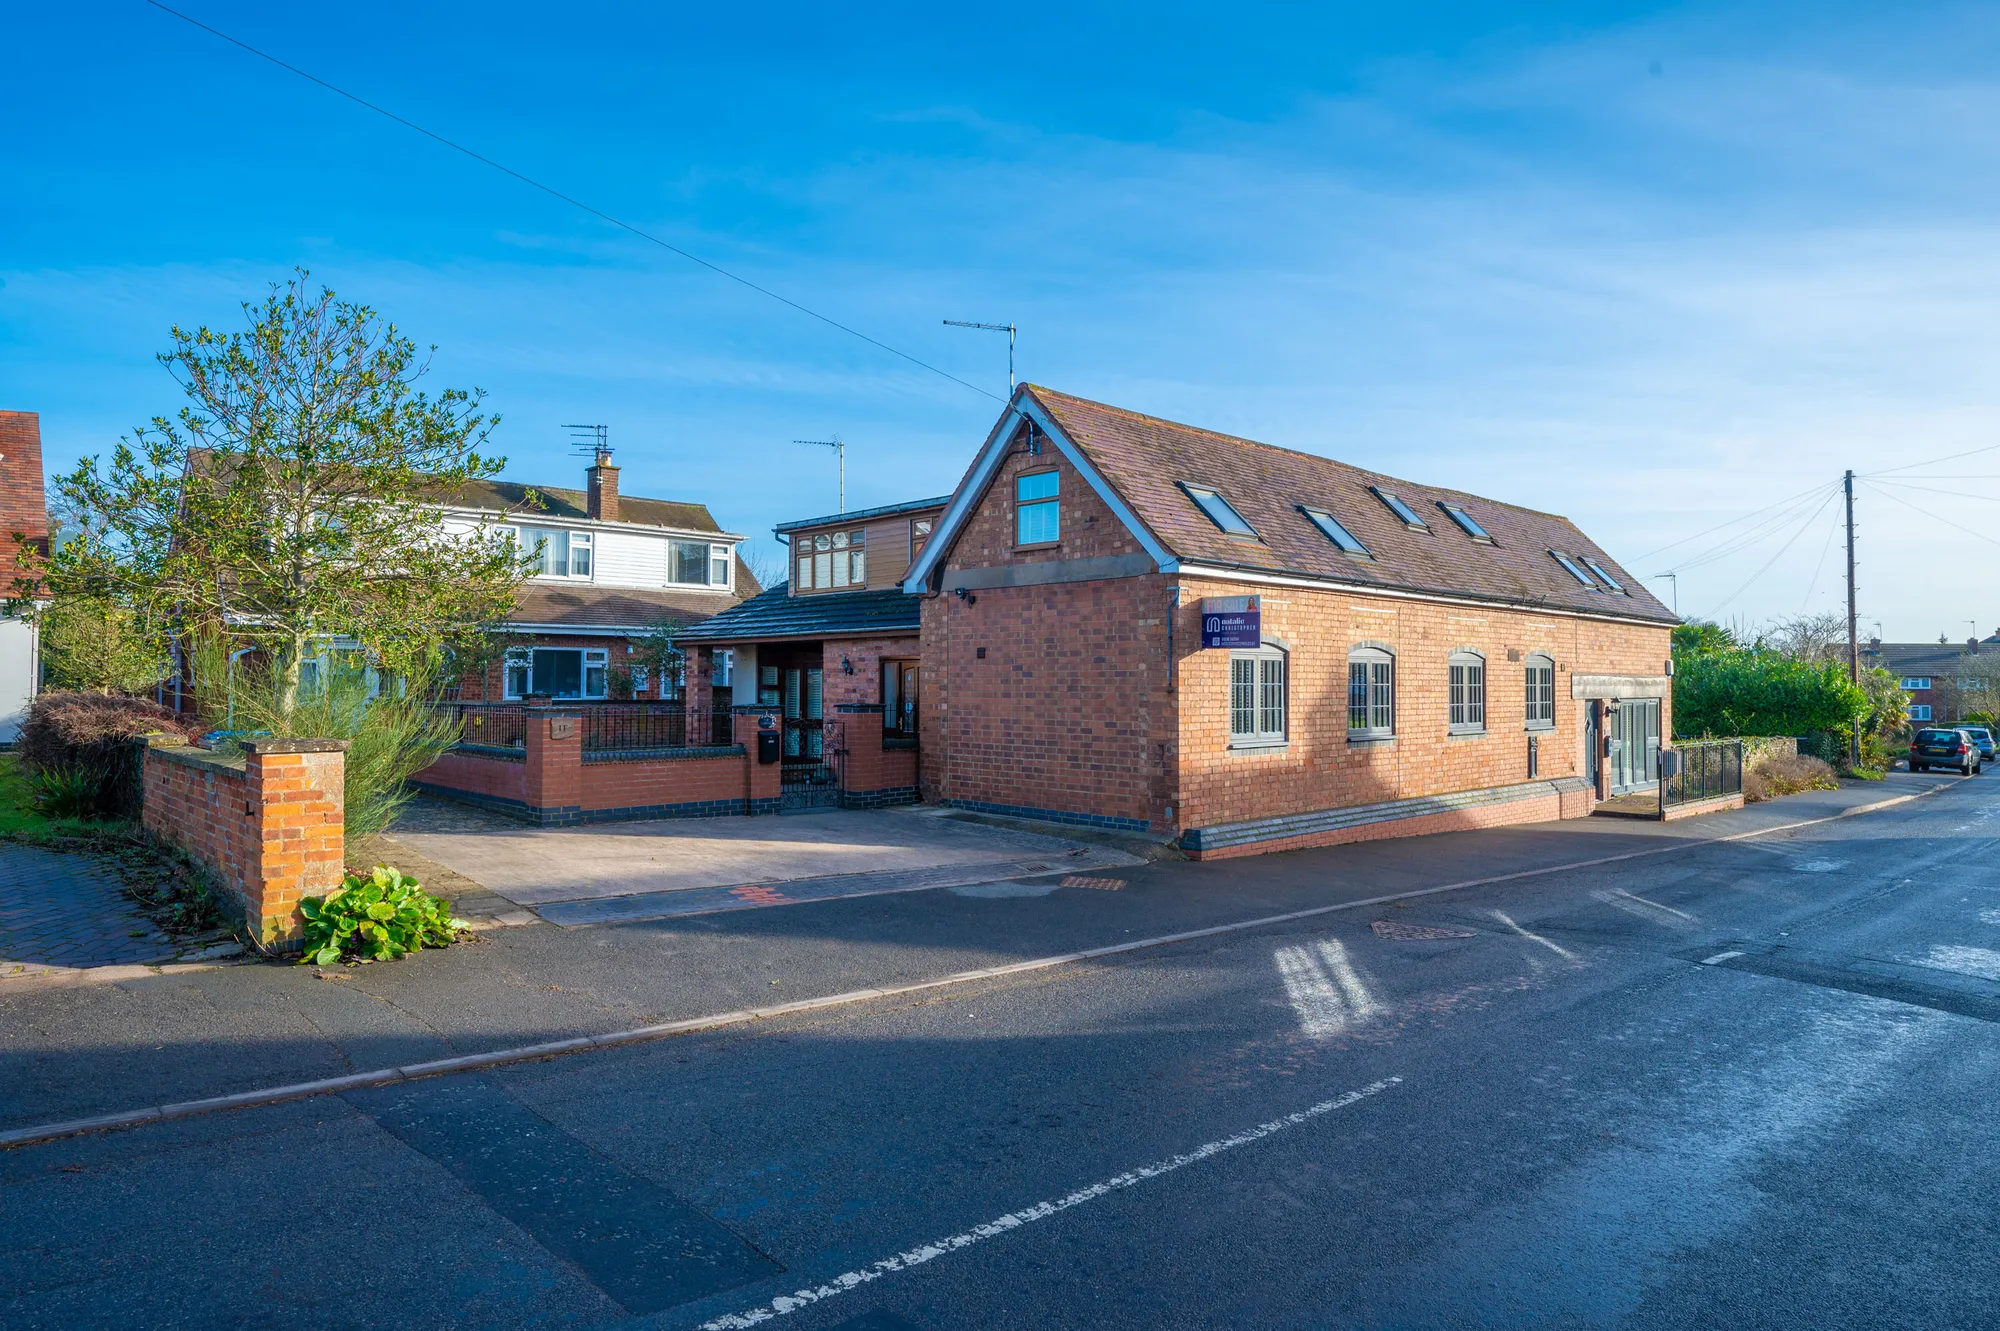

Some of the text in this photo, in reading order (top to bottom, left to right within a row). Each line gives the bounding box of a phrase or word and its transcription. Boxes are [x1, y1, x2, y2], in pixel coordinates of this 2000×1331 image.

[1206, 598, 1245, 613] FOR SALE
[1221, 617, 1245, 625] natalie
